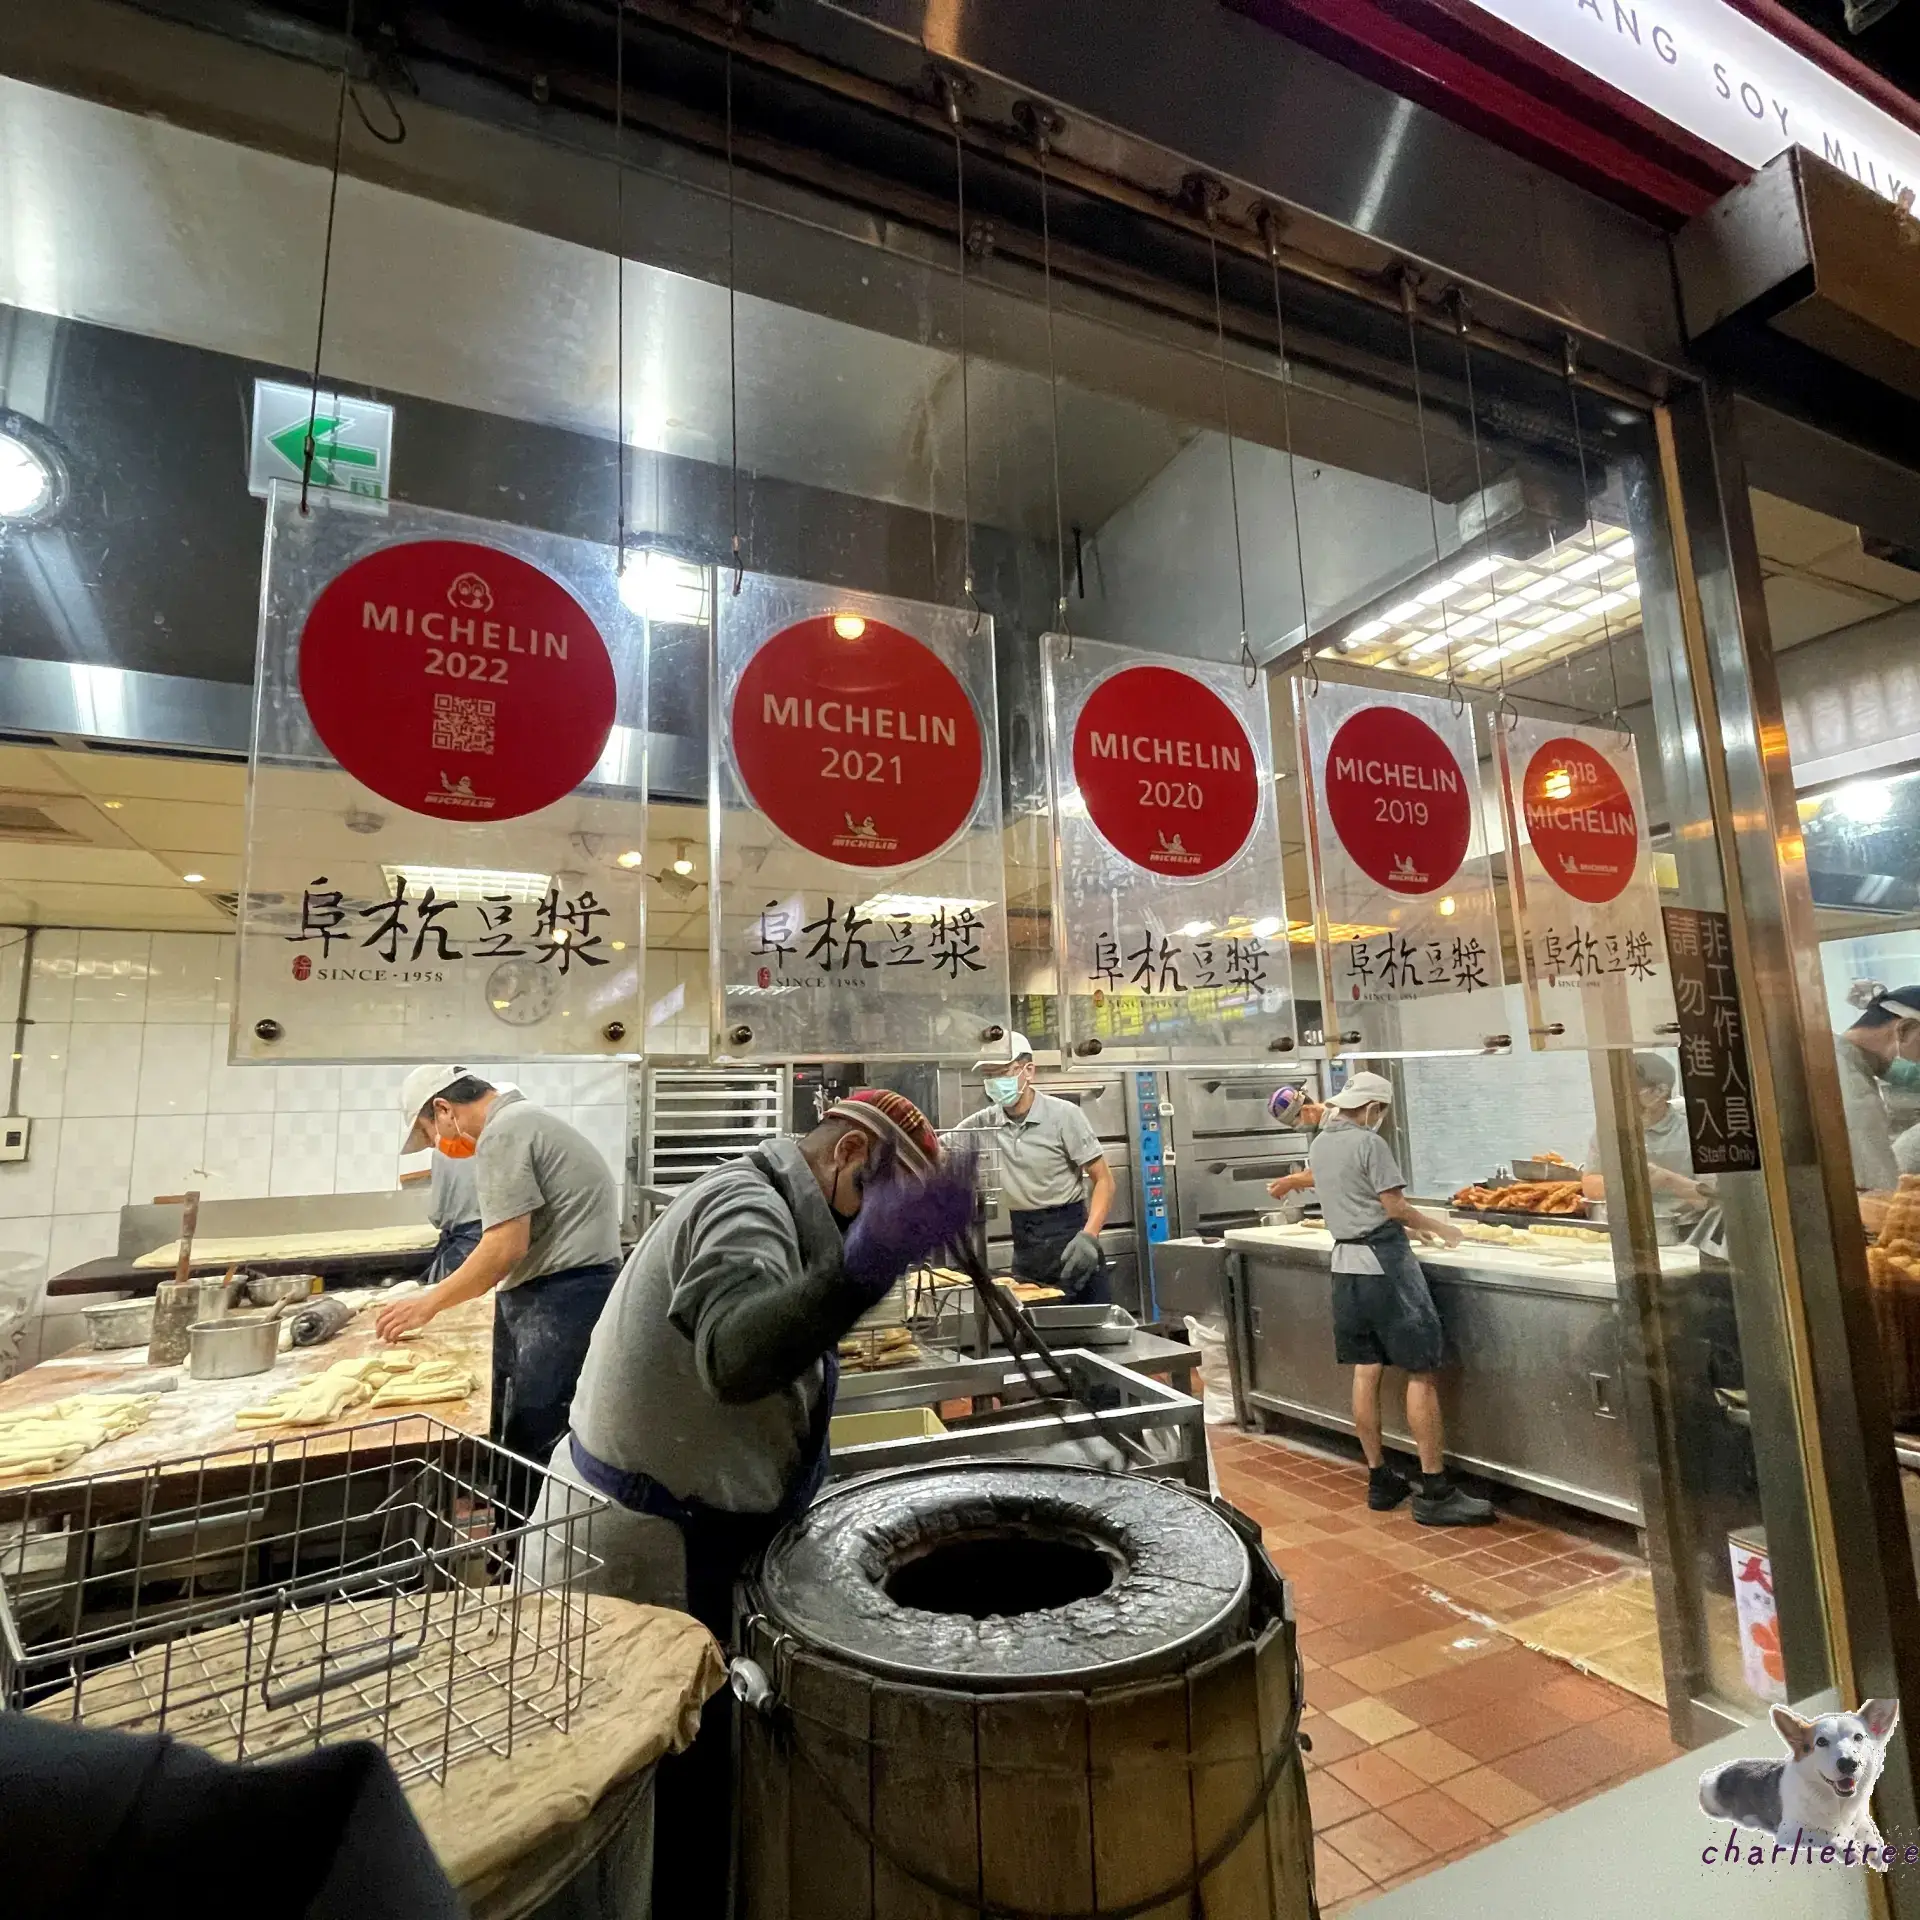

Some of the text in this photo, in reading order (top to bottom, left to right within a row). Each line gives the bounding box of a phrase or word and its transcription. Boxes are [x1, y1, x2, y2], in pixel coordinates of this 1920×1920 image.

[1713, 63, 1788, 136] SOY
[362, 601, 569, 660] MICHELIN
[423, 648, 510, 685] 2022
[762, 693, 956, 747] MICHELIN
[820, 747, 902, 785] 2021
[1089, 731, 1242, 772] MICHELIN
[1335, 756, 1458, 793] MICHELIN
[1138, 780, 1203, 810] 2020
[1374, 798, 1429, 826] 2019
[1526, 803, 1635, 836] MICHELIN
[316, 968, 444, 983] SINCE 1958
[1668, 914, 1724, 1140] 請勿進入
[1700, 917, 1754, 1139] 非工作人員
